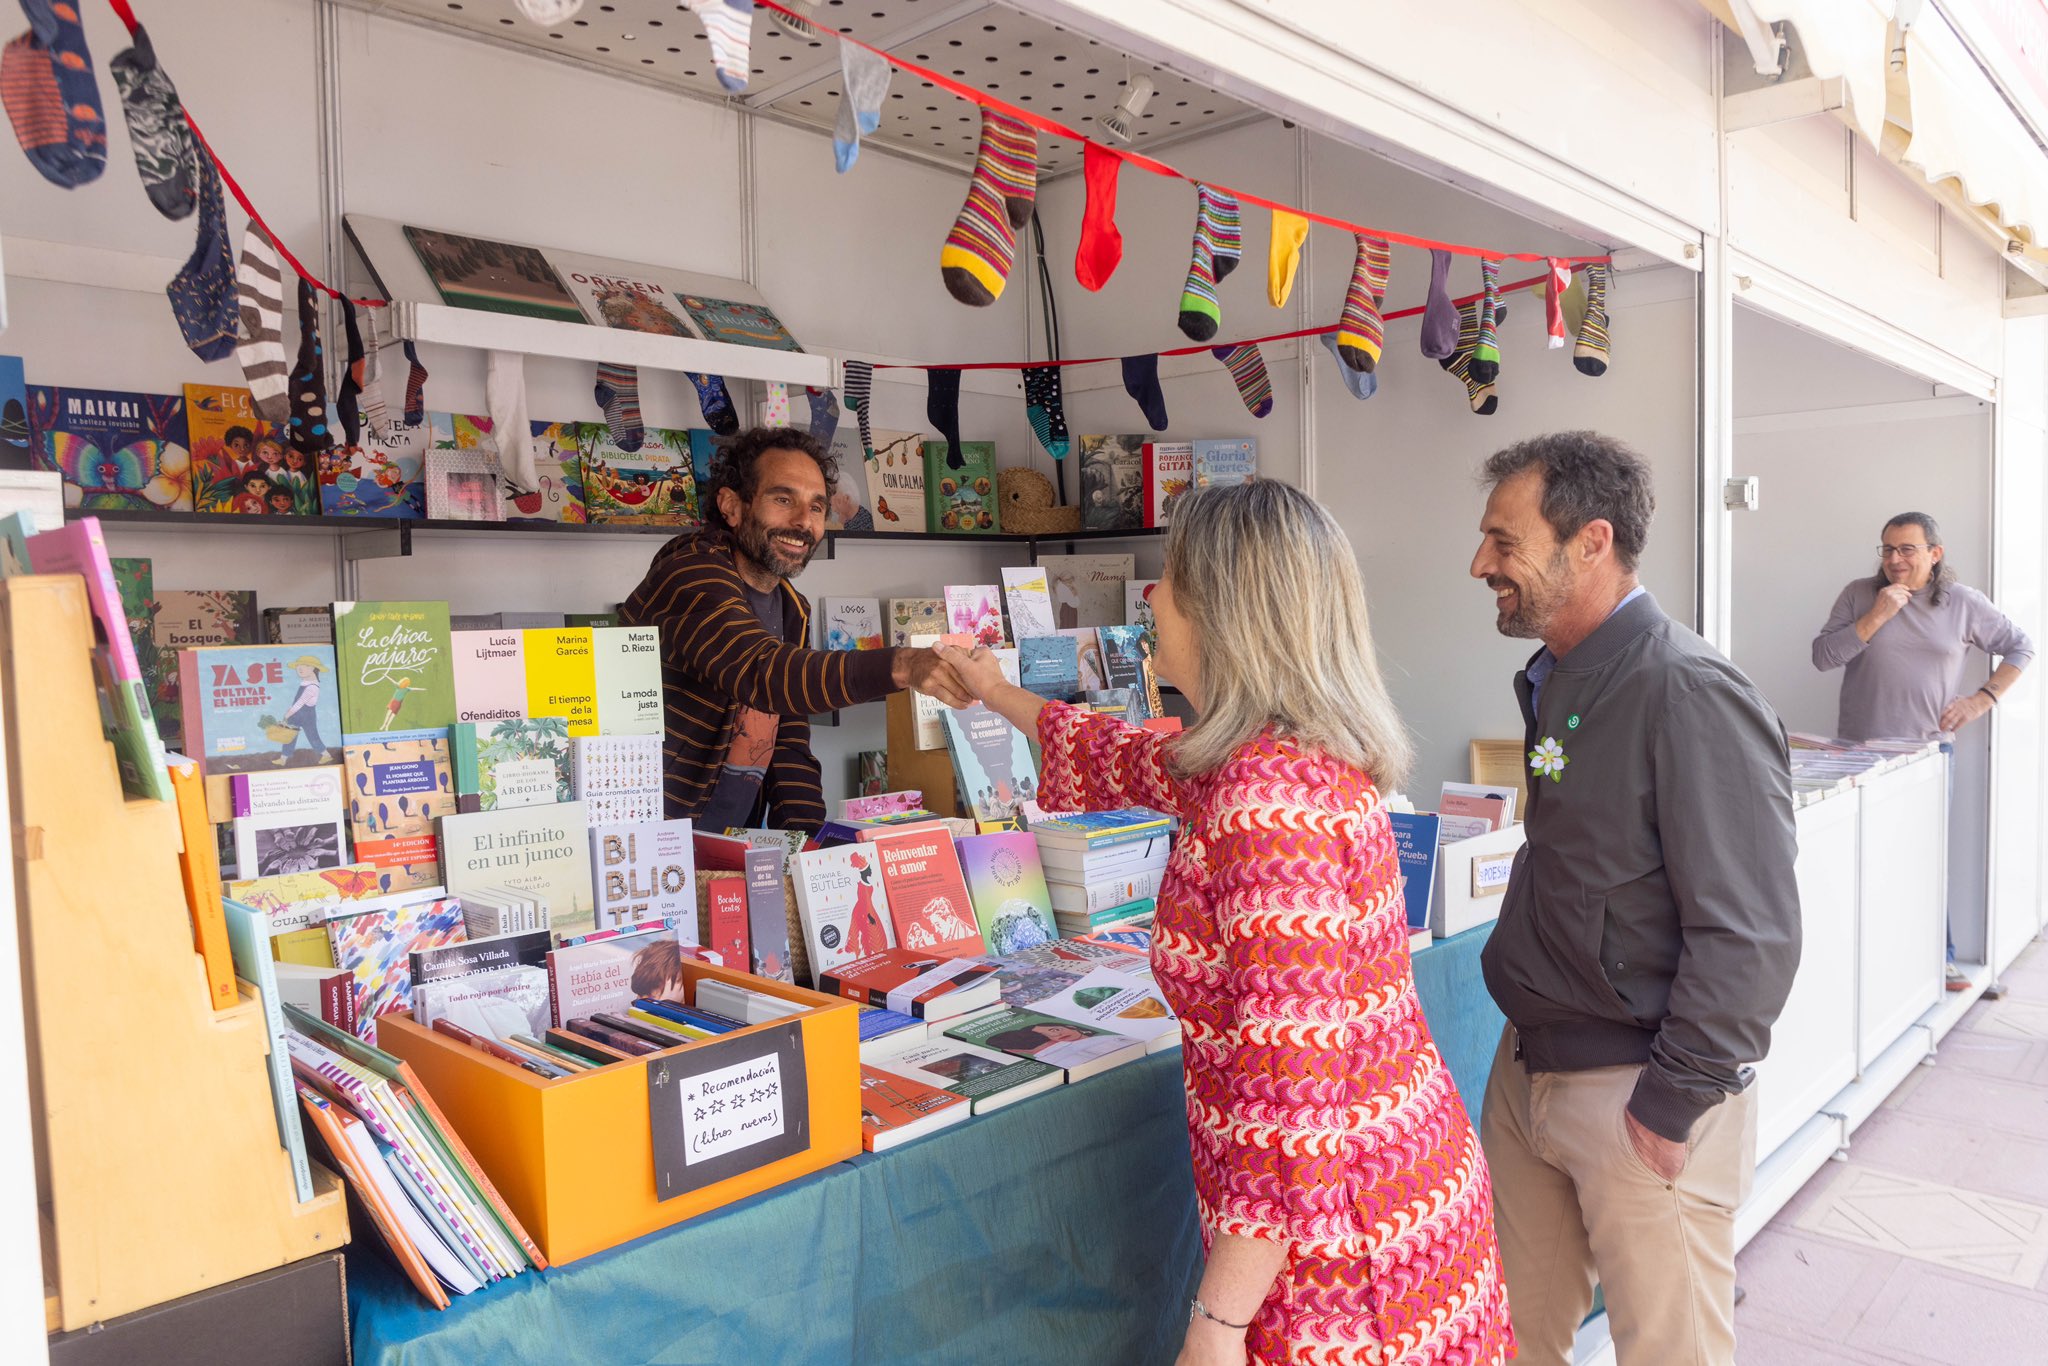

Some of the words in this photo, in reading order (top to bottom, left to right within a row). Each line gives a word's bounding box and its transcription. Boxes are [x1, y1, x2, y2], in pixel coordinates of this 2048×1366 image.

[571, 273, 665, 295] ORIGEN
[221, 393, 235, 408] El
[67, 398, 140, 419] MAIKAI
[79, 418, 106, 427] belleza
[109, 419, 140, 428] invisible
[601, 451, 643, 461] BIBLIOTECA
[645, 455, 671, 463] PIRATA
[1206, 450, 1246, 461] Gloria
[1114, 458, 1141, 466] Caracol
[1159, 461, 1194, 471] GITAN
[1202, 462, 1250, 473] Fuertes
[882, 473, 898, 488] CON
[899, 474, 924, 490] CALMA
[840, 605, 866, 614] LOGOS
[188, 619, 202, 630] El
[170, 633, 222, 646] bosque
[357, 626, 379, 648] La
[380, 625, 432, 647] chica
[489, 636, 516, 646] Lucía
[556, 635, 588, 645] Marina
[628, 633, 655, 642] Marta
[476, 649, 517, 660] Lijtmaer
[556, 646, 589, 656] Garcés
[621, 645, 631, 653] D.
[632, 644, 655, 652] Riezu
[361, 647, 437, 677] pájaro
[211, 664, 242, 687] YA
[246, 658, 284, 684] SÉ
[213, 687, 266, 698] CULTIVAR
[621, 690, 632, 699] La
[633, 689, 658, 698] moda
[214, 699, 228, 708] EL
[549, 696, 557, 705] El
[558, 695, 591, 706] tiempo
[638, 700, 659, 711] justa
[461, 709, 521, 721] Ofendiditos
[571, 706, 582, 715] de
[584, 705, 592, 714] la
[567, 717, 593, 726] omesa
[971, 719, 993, 730] Cuentos
[994, 717, 1003, 726] de
[971, 731, 978, 740] la
[501, 783, 553, 796] ÁRBOLES
[605, 788, 640, 796] cromática
[253, 800, 286, 809] Salvando
[286, 798, 296, 806] las
[297, 796, 330, 804] distancias
[473, 835, 493, 852] El
[499, 828, 565, 848] infinito
[755, 835, 783, 847] CASITA
[1402, 841, 1413, 849] de
[603, 832, 637, 866] BI
[882, 844, 938, 863] Reinventar
[467, 855, 489, 871] en
[496, 853, 519, 867] un
[525, 846, 573, 868] junco
[1398, 850, 1428, 861] Prueba
[754, 864, 775, 872] Cuentos
[887, 863, 898, 877] el
[900, 860, 927, 875] amor
[504, 878, 522, 886] TYTO
[605, 864, 686, 901] BLIO
[809, 872, 836, 882] OCTAVIA
[810, 876, 852, 893] BUTLER
[717, 892, 742, 905] Bocados
[661, 908, 688, 917] historia
[272, 914, 309, 927] CUAD
[424, 960, 456, 972] Camila
[458, 956, 478, 966] Sosa
[479, 949, 510, 962] Villada
[571, 969, 602, 986] Había
[605, 965, 621, 978] del
[571, 983, 601, 997] verbo
[604, 982, 610, 990] a
[613, 977, 629, 988] ver
[448, 993, 468, 1003] Todo
[469, 991, 486, 1000] rojo
[487, 989, 502, 998] por
[503, 984, 530, 993] dentro
[345, 980, 353, 1022] SAMPEDRO
[966, 1020, 1001, 1036] Material
[702, 1062, 775, 1097] Recomendación
[693, 1127, 732, 1153] (libros
[741, 1109, 778, 1131] nuevos)
